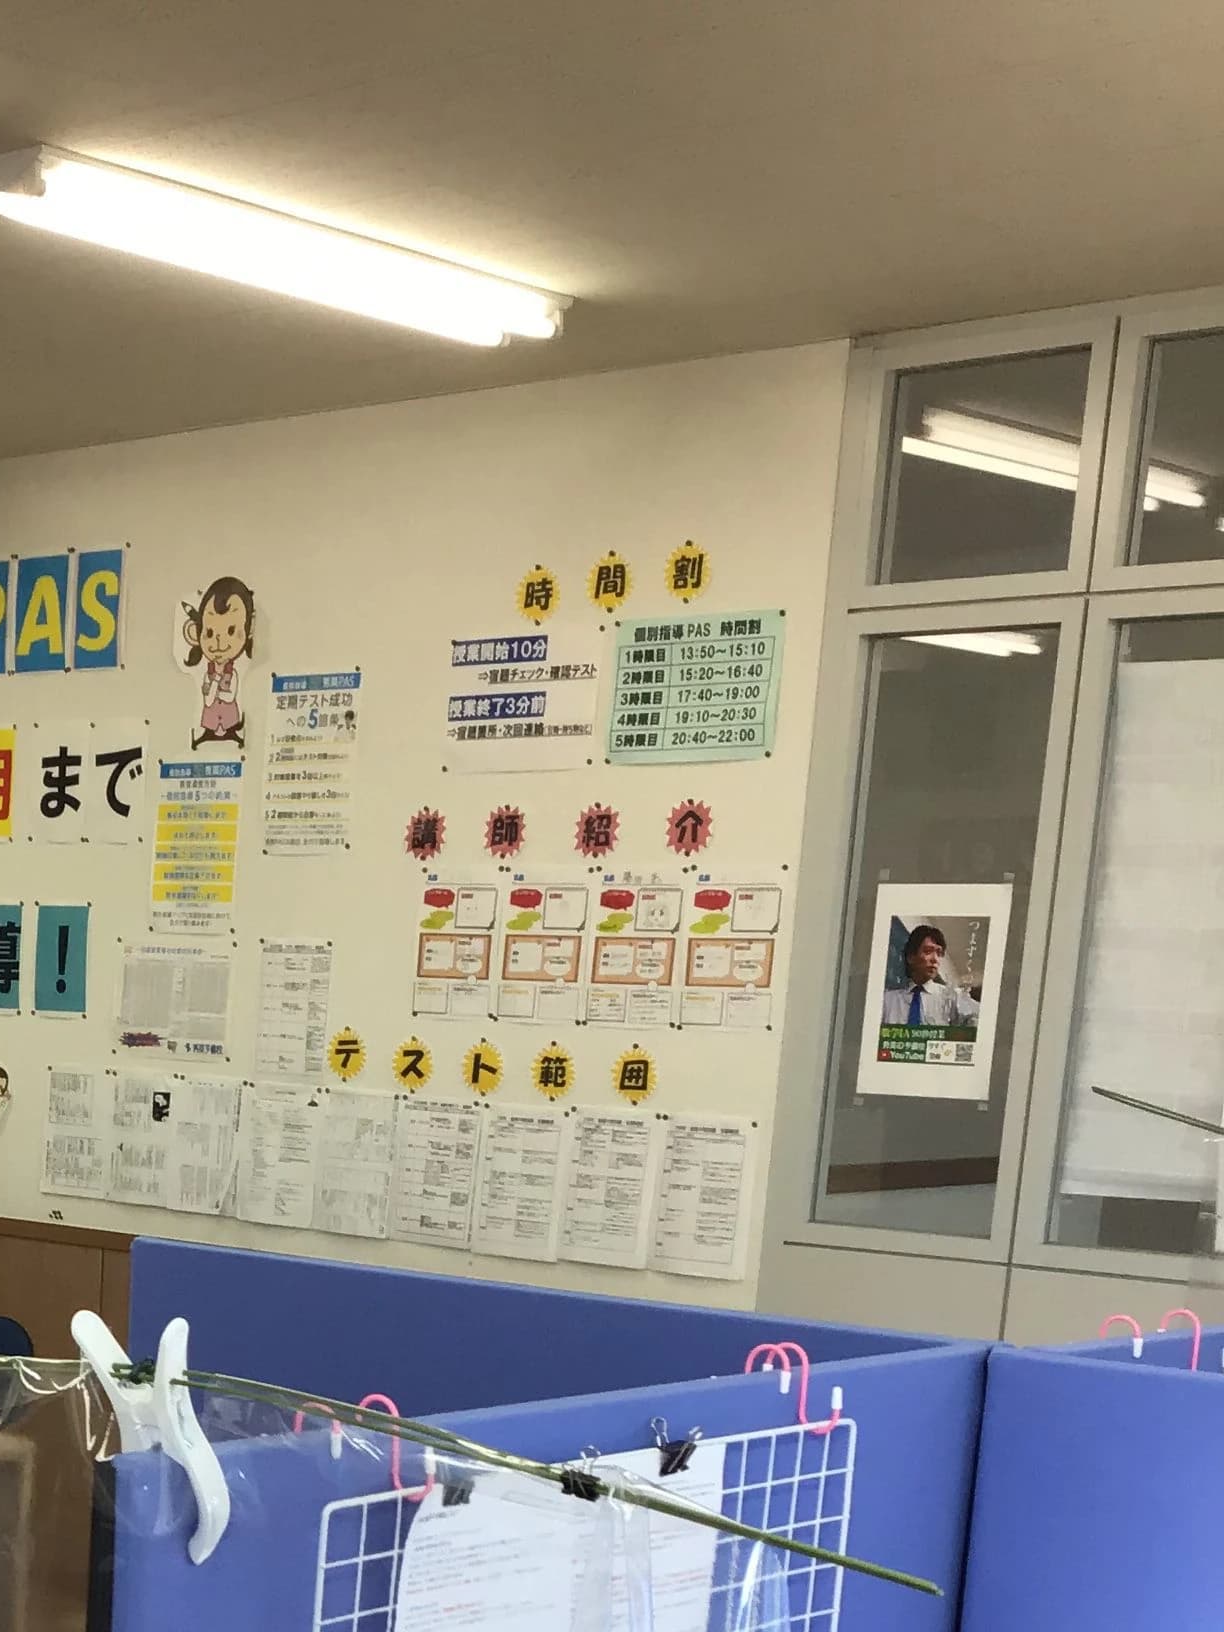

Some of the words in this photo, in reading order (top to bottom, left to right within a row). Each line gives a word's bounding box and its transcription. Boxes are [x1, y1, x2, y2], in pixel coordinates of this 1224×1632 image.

[523, 553, 704, 612] 時間割
[635, 624, 684, 643] 個別指導
[687, 622, 712, 638] PAS
[720, 618, 762, 637] 時間割
[452, 638, 547, 664] 授業開始10分
[625, 648, 666, 664] 1時限目
[622, 669, 665, 685] 2時限目
[276, 692, 353, 710] 定期テスト成功
[448, 695, 546, 719] 授業終了3分前
[620, 690, 663, 706] 3時限目
[617, 711, 661, 727] 4時限目
[615, 733, 658, 748] 5時限目
[410, 810, 704, 849] 講師紹介
[334, 1039, 649, 1091] テスト範囲
